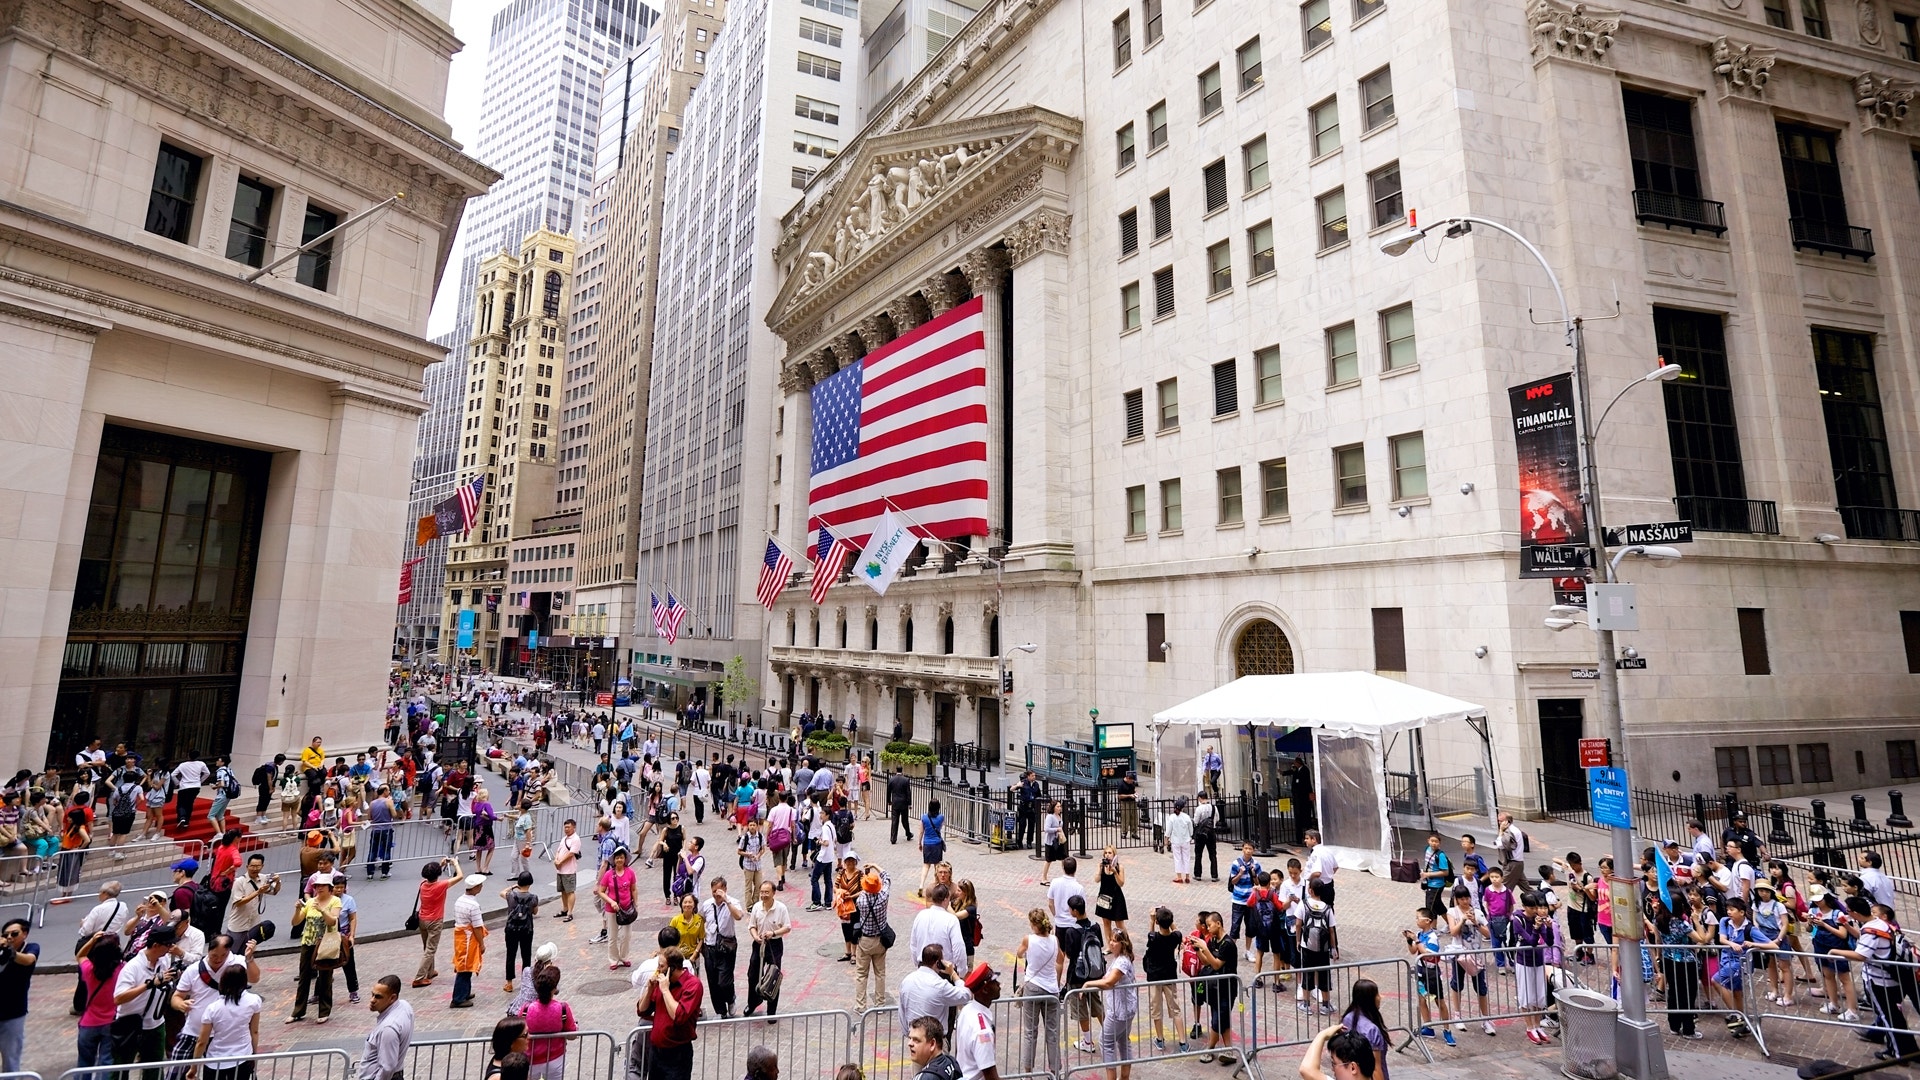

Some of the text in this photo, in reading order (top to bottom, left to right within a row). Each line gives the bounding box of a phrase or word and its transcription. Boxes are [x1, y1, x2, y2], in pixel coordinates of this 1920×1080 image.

[1526, 383, 1553, 400] NYC
[1516, 407, 1572, 429] FINANCIAL
[1629, 526, 1689, 542] NASSAU ST
[875, 540, 888, 560] NYSE
[1535, 551, 1566, 564] WALL
[1569, 593, 1584, 603] bgc
[1625, 660, 1641, 668] WALL
[1600, 769, 1615, 780] 9/11
[1595, 778, 1622, 788] MEMORIAL
[1603, 788, 1625, 797] ENTRY
